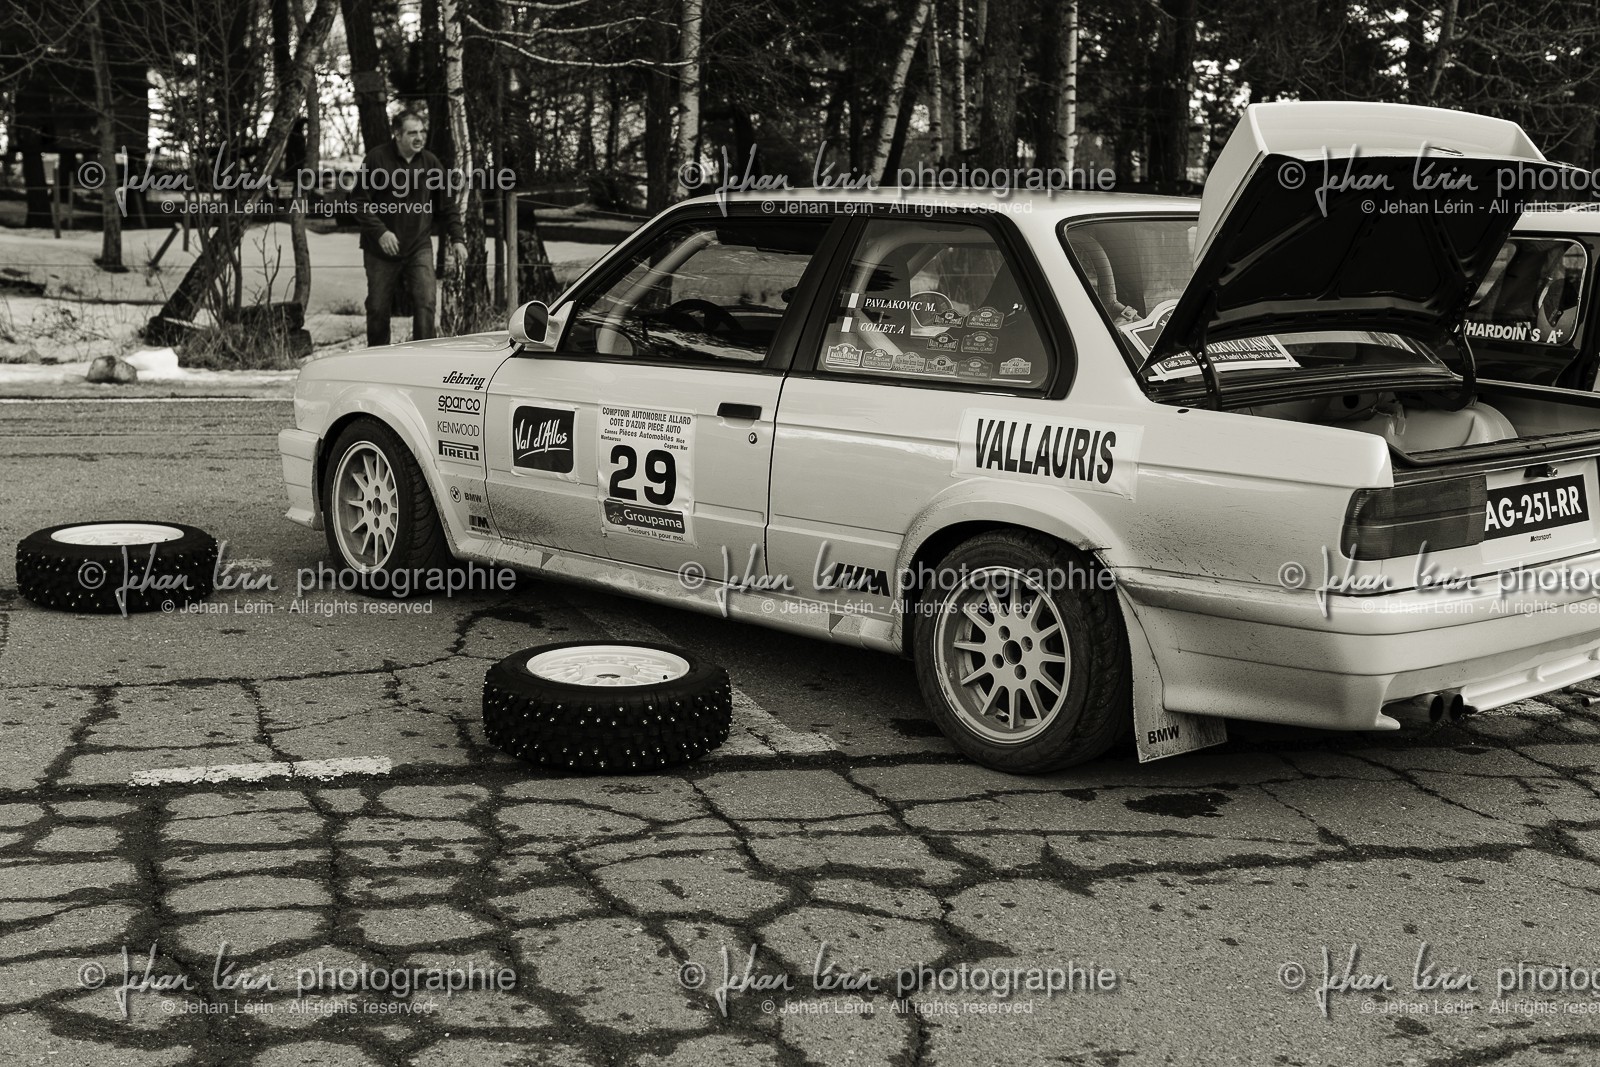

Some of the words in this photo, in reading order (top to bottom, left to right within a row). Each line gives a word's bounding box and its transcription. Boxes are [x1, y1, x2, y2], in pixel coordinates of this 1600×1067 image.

[865, 298, 922, 311] PAVLAKOVIC
[925, 302, 936, 312] M.
[897, 325, 906, 334] A
[443, 371, 486, 390] Sebring
[438, 395, 481, 413] sparco
[602, 406, 630, 418] COMPTOIR
[632, 410, 667, 422] AUTOMOBILE
[668, 414, 691, 425] ALLARD
[437, 420, 480, 437] KENWOOD
[609, 417, 624, 427] COTE
[625, 419, 646, 430] D'AZUR
[647, 422, 664, 432] PIECE
[665, 424, 681, 434] AUTO
[515, 418, 533, 450] Val
[533, 418, 568, 453] d'Allos
[638, 430, 674, 442] Automobiles
[438, 440, 480, 461] PIRELLI
[975, 418, 1117, 484] VALLAURIS
[609, 444, 677, 506] 29
[464, 492, 482, 503] BMW
[1484, 485, 1583, 532] AG-251-RR
[623, 509, 683, 528] Groupama
[627, 526, 650, 536] Toujours
[658, 532, 671, 540] pour
[1529, 533, 1552, 542] Motorsport
[1147, 725, 1180, 744] BMW
